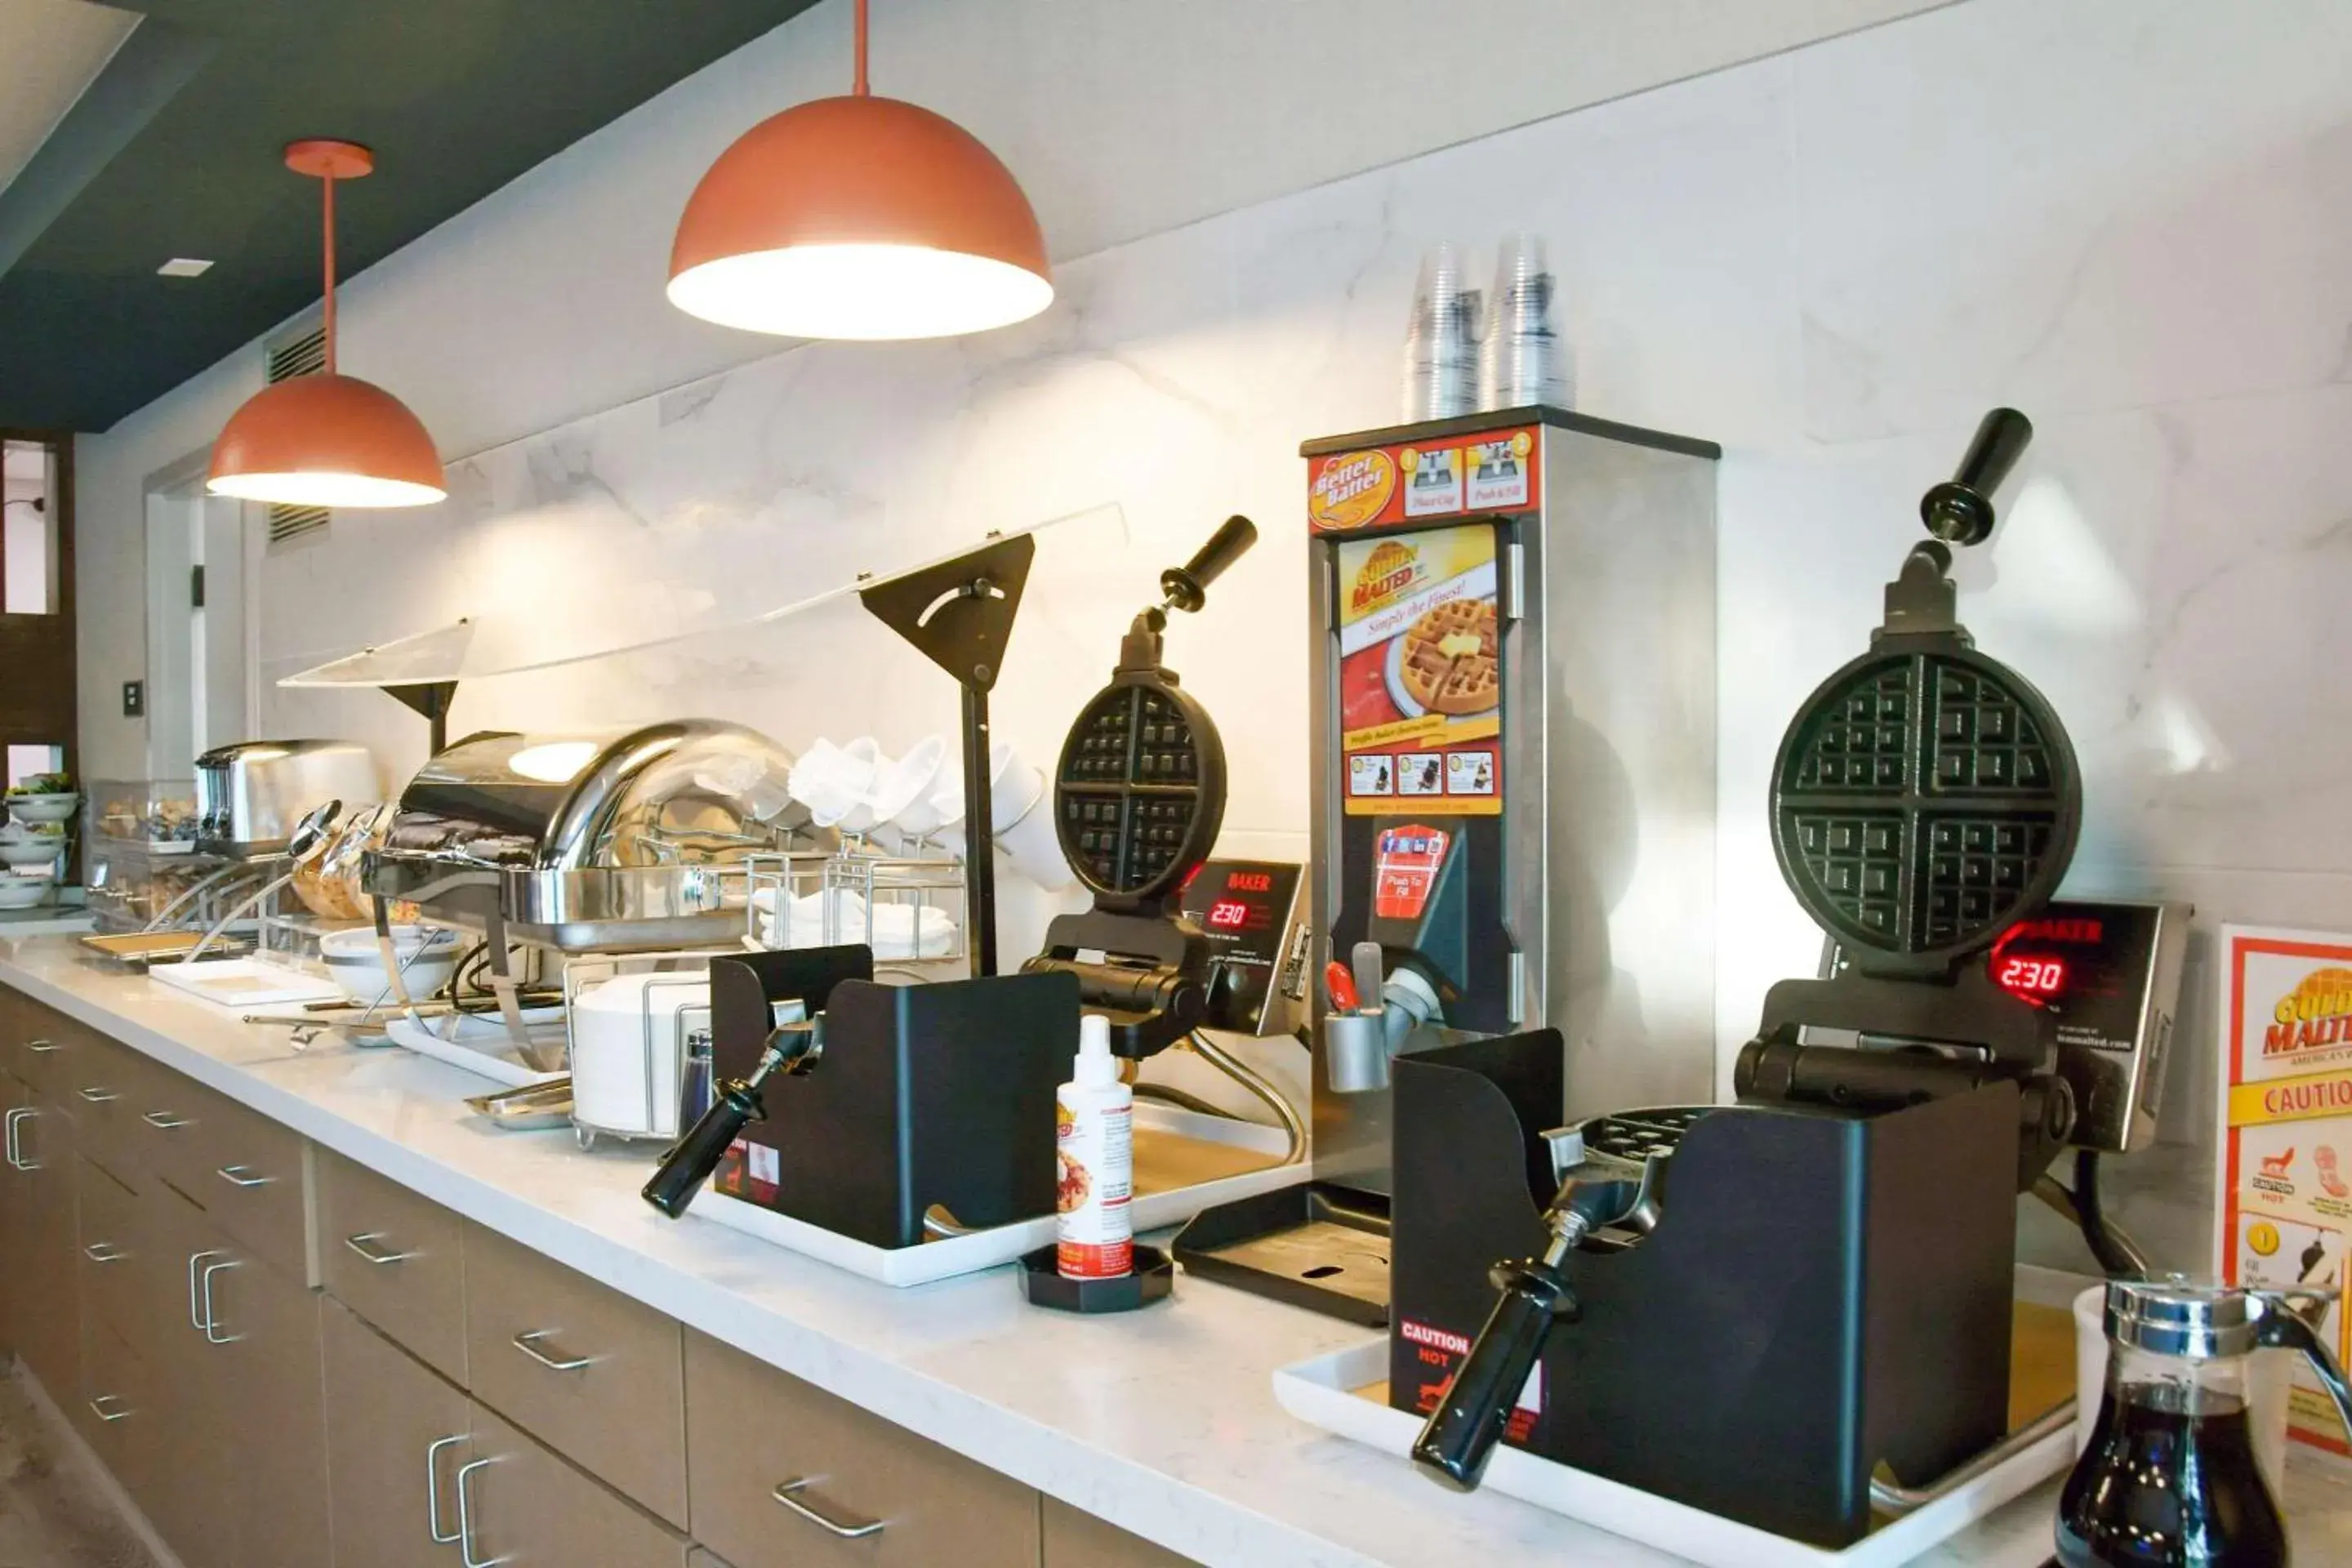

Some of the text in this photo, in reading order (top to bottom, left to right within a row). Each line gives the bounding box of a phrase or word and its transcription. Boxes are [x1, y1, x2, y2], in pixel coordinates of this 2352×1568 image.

[1316, 456, 1373, 497] Better
[1328, 468, 1383, 507] Batter
[1352, 567, 1414, 609] MALTED
[1227, 872, 1271, 892] BAKER
[1210, 903, 1247, 924] 230
[1401, 1321, 1469, 1354] CAUTION
[1419, 1348, 1449, 1367] HOT
